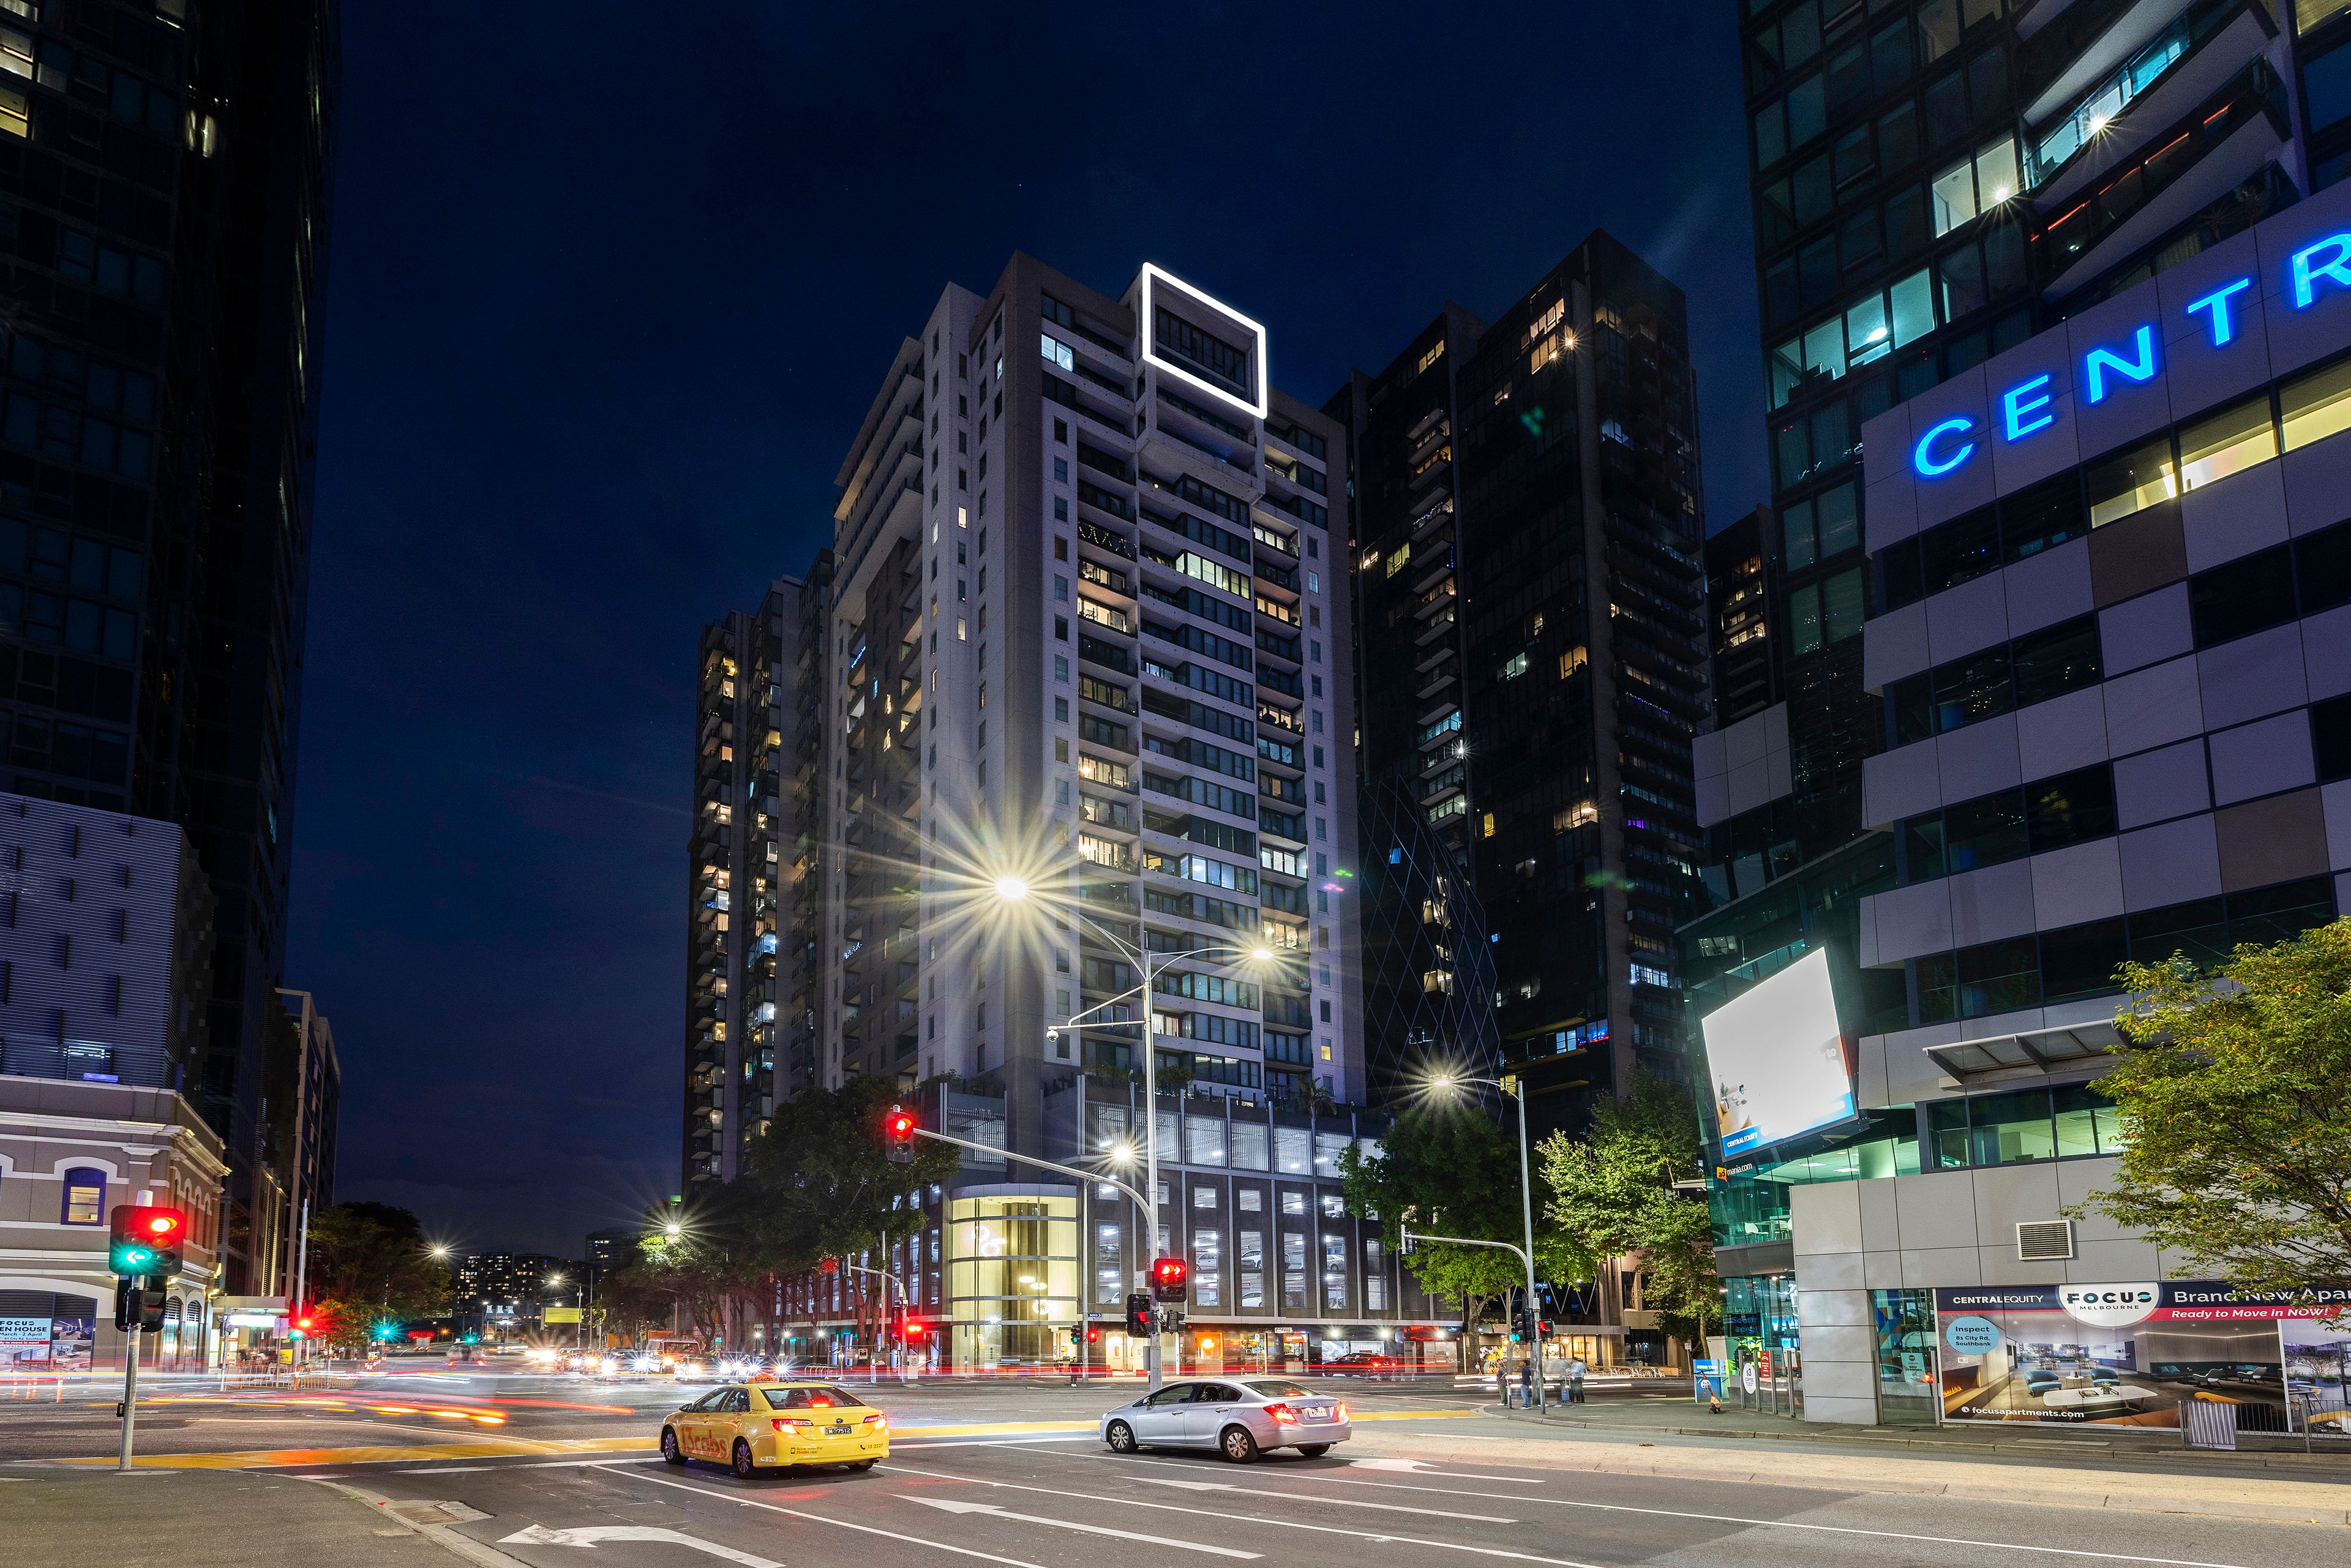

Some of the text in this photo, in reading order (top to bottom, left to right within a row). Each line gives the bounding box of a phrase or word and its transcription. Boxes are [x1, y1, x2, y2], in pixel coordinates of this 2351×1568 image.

[1914, 233, 2351, 476] CENTR
[2067, 1291, 2152, 1304] FOCUS
[2173, 1289, 2237, 1303] Brand
[2244, 1289, 2295, 1302] New
[2172, 1310, 2210, 1319] Ready
[2271, 1308, 2284, 1317] in
[2287, 1308, 2329, 1316] NOW!
[1972, 1406, 2085, 1418] focusapartments.com
[681, 1426, 727, 1458] 13cabs
